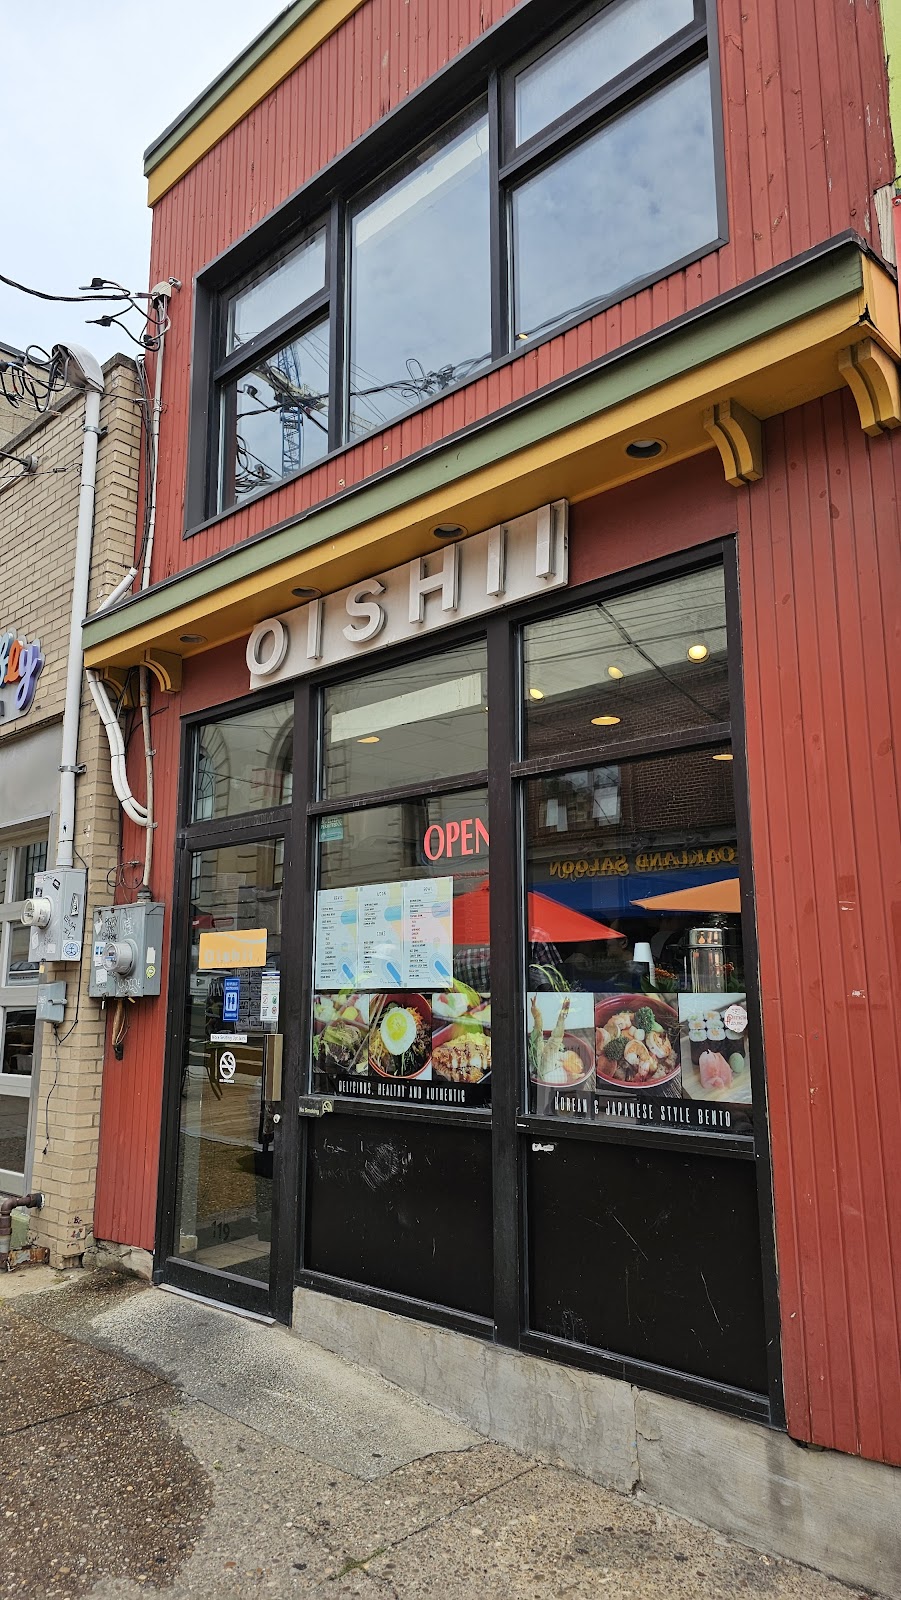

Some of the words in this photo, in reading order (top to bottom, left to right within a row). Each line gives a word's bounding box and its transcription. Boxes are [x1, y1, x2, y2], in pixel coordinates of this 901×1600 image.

[246, 503, 556, 677] OISHII
[424, 818, 489, 860] OPEN
[377, 1083, 405, 1098] HEALTHY
[409, 1085, 422, 1099] AND
[426, 1087, 466, 1103] AUTHENTIC
[554, 1094, 588, 1113] KOREAN
[605, 1101, 654, 1120] JAPANESE
[660, 1105, 691, 1124] STYLE
[698, 1108, 731, 1128] BENTO
[211, 1220, 230, 1241] 119
